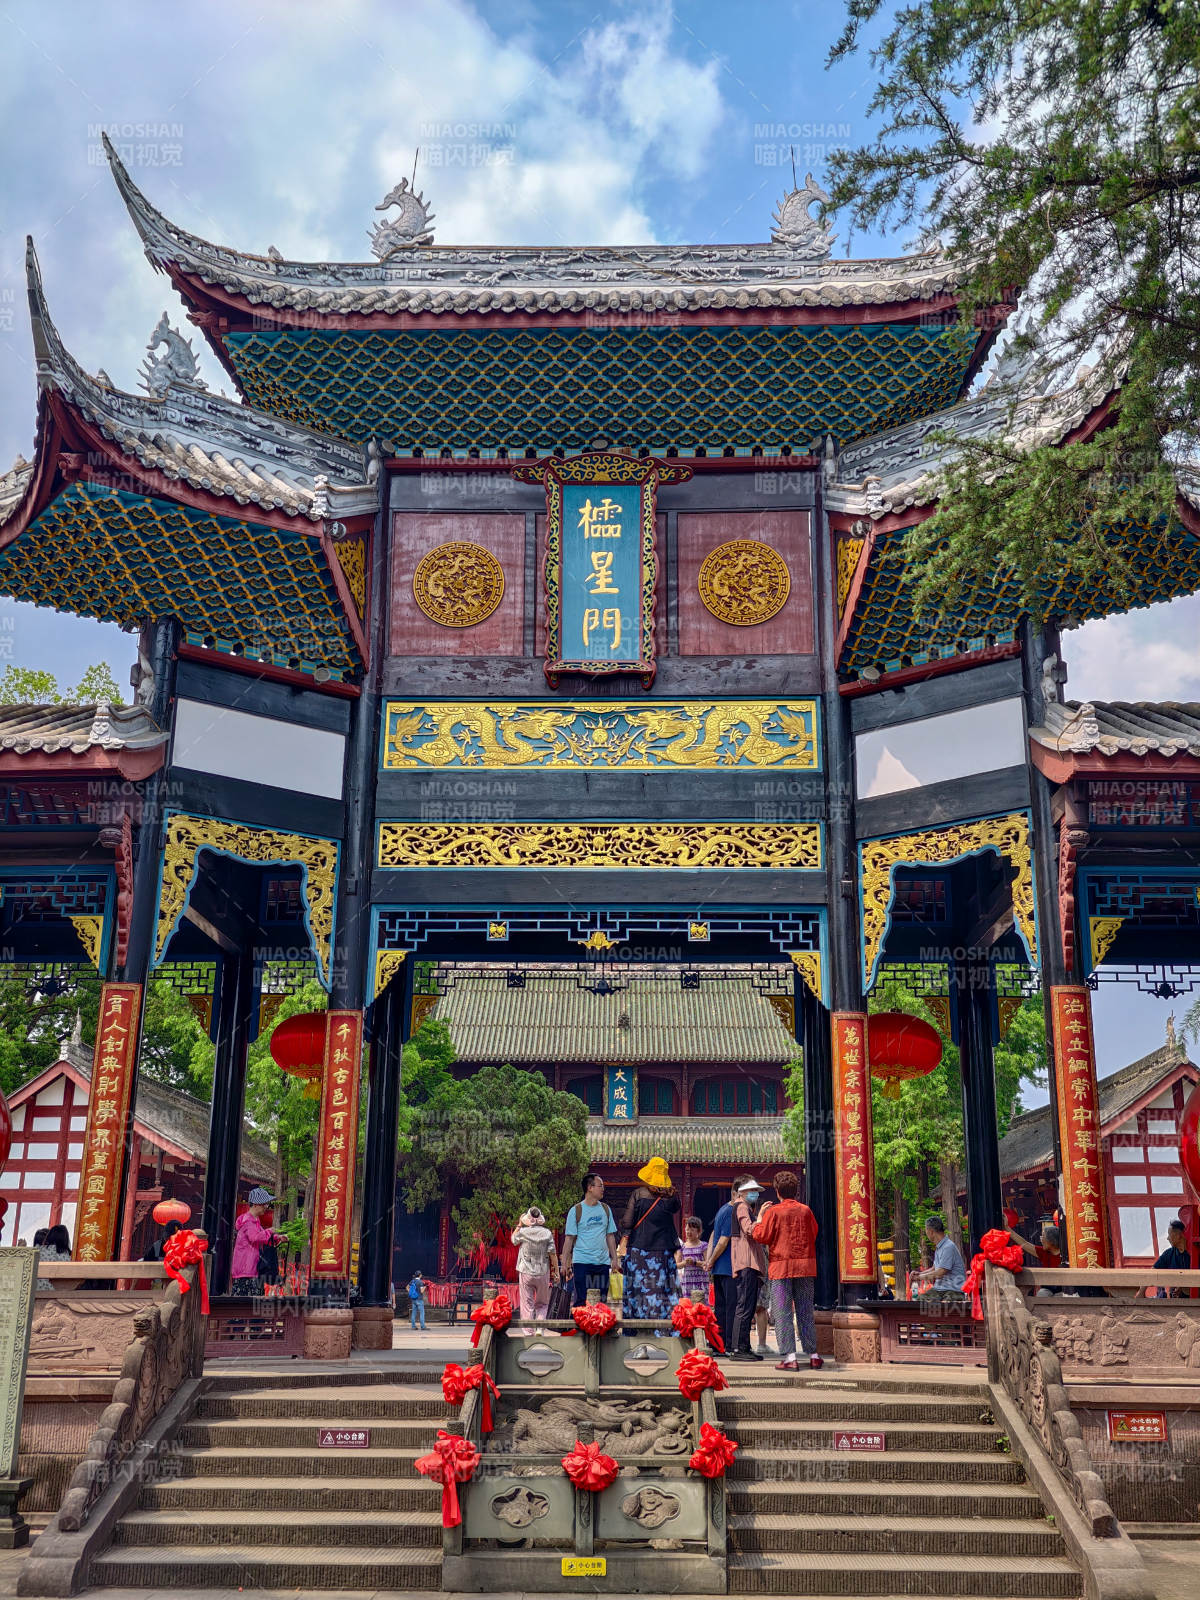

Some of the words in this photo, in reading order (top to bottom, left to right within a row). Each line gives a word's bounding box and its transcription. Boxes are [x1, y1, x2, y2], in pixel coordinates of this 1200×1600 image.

[613, 1068, 628, 1118] 大成殿
[336, 1432, 365, 1441] 小心台阶
[851, 1435, 881, 1444] 小心台阶
